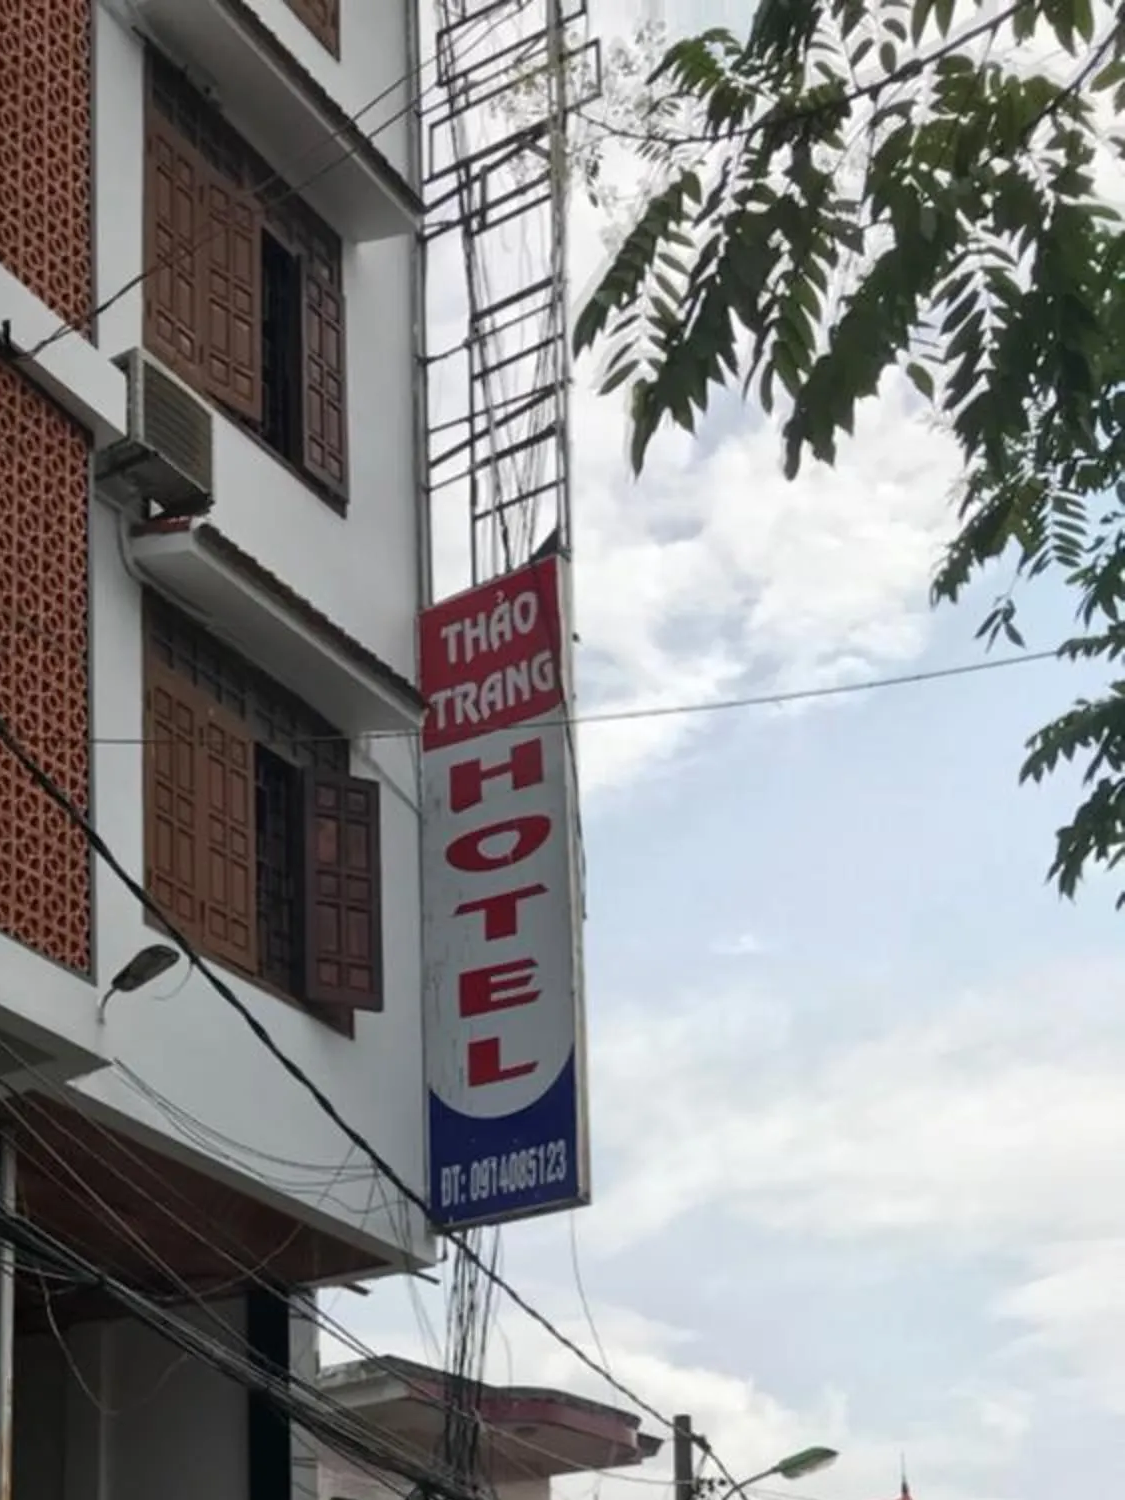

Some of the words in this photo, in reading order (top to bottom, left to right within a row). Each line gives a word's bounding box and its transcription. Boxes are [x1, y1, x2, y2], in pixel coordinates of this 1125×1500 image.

[441, 590, 539, 664] THẢO
[430, 651, 556, 730] TRANG
[445, 737, 551, 1088] HOTEL
